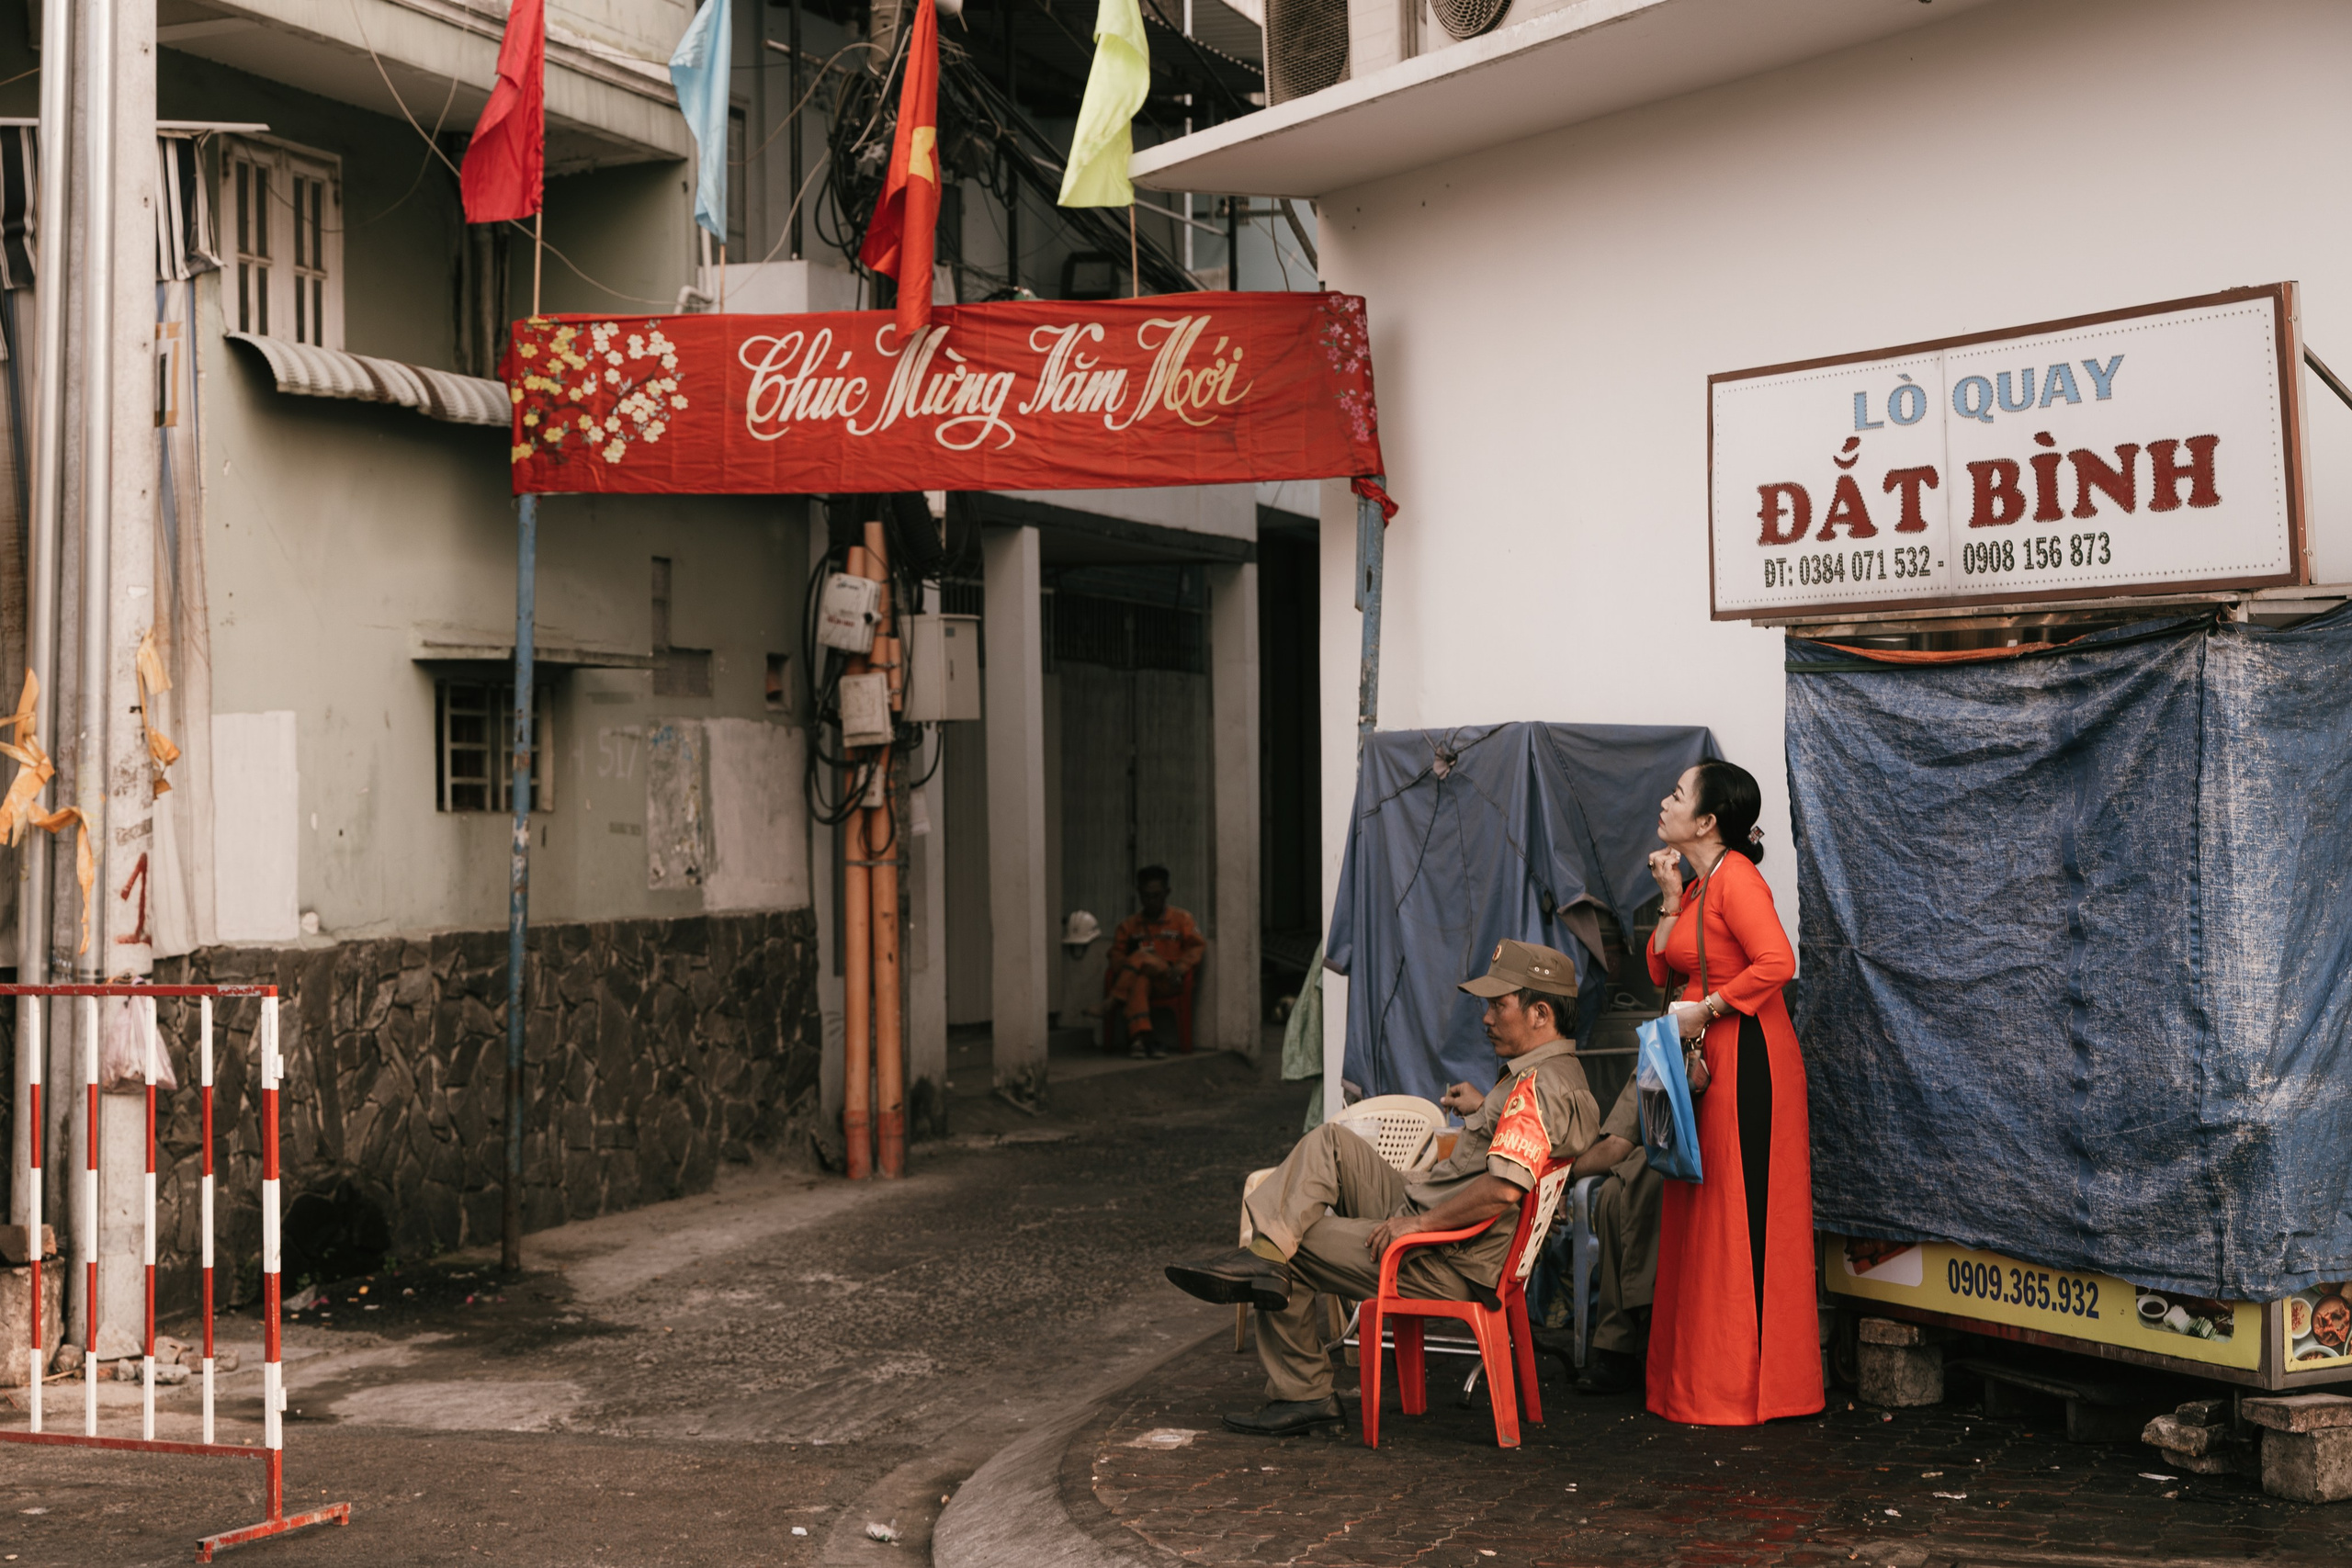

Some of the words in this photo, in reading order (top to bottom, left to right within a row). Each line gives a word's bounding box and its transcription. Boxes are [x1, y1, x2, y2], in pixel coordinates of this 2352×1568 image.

[738, 327, 871, 441] Chúc
[846, 323, 1016, 451] Mừng
[1019, 321, 1129, 415] Năm
[1104, 314, 1254, 432] Mới
[1853, 373, 1928, 432] LÒ
[1951, 355, 2125, 423] QUAY
[1757, 435, 1939, 547] ĐẮT
[1966, 431, 2222, 528] BÌNH
[1764, 556, 1793, 588] ĐT:
[1799, 552, 1846, 585] 0384
[1851, 549, 1887, 581] 071
[1894, 546, 1930, 579] 532
[1962, 539, 2015, 575] 0908
[2024, 536, 2063, 570] 156
[2070, 532, 2112, 566] 873
[1948, 1258, 2099, 1319] 0909.365.932
